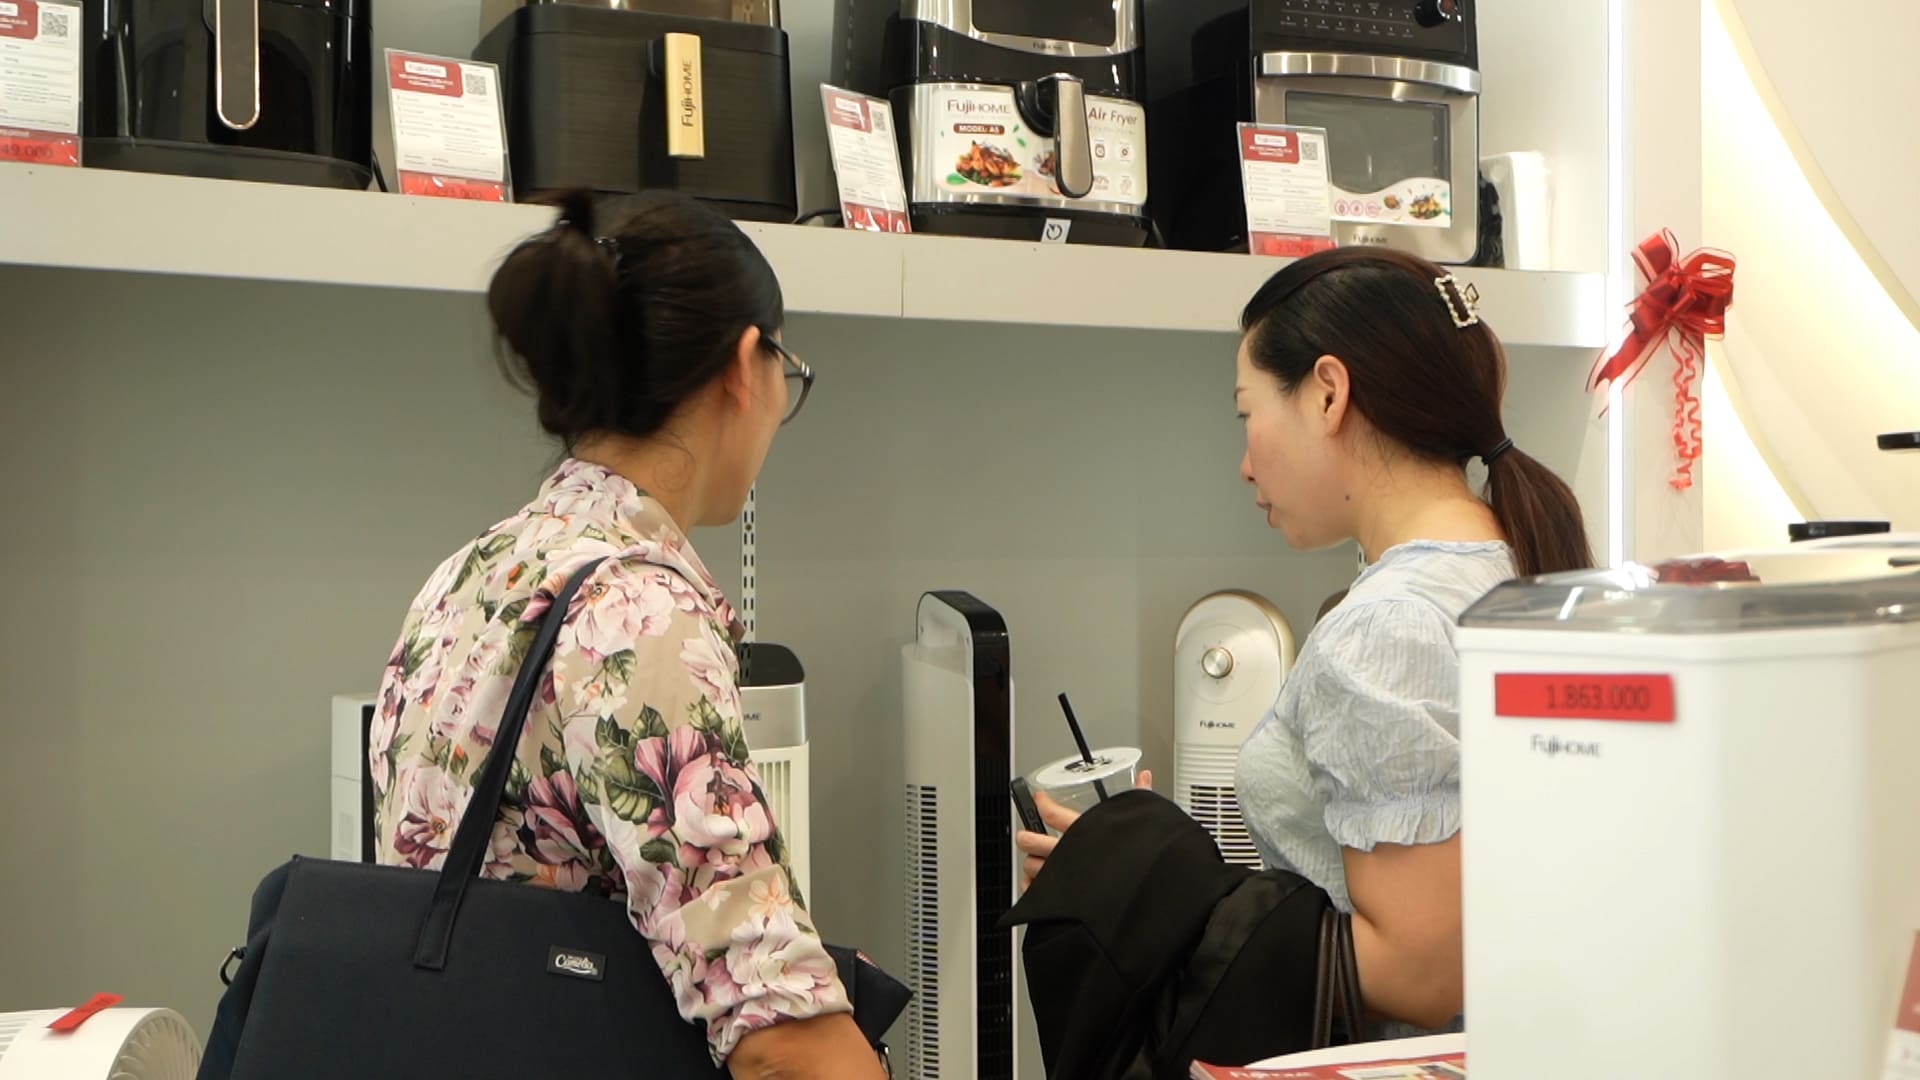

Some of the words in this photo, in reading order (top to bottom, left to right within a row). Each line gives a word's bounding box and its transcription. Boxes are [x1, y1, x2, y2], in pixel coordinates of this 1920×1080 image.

[1088, 107, 1106, 121] Air
[1110, 110, 1137, 126] Fryer
[1546, 684, 1650, 711] 1.863.000
